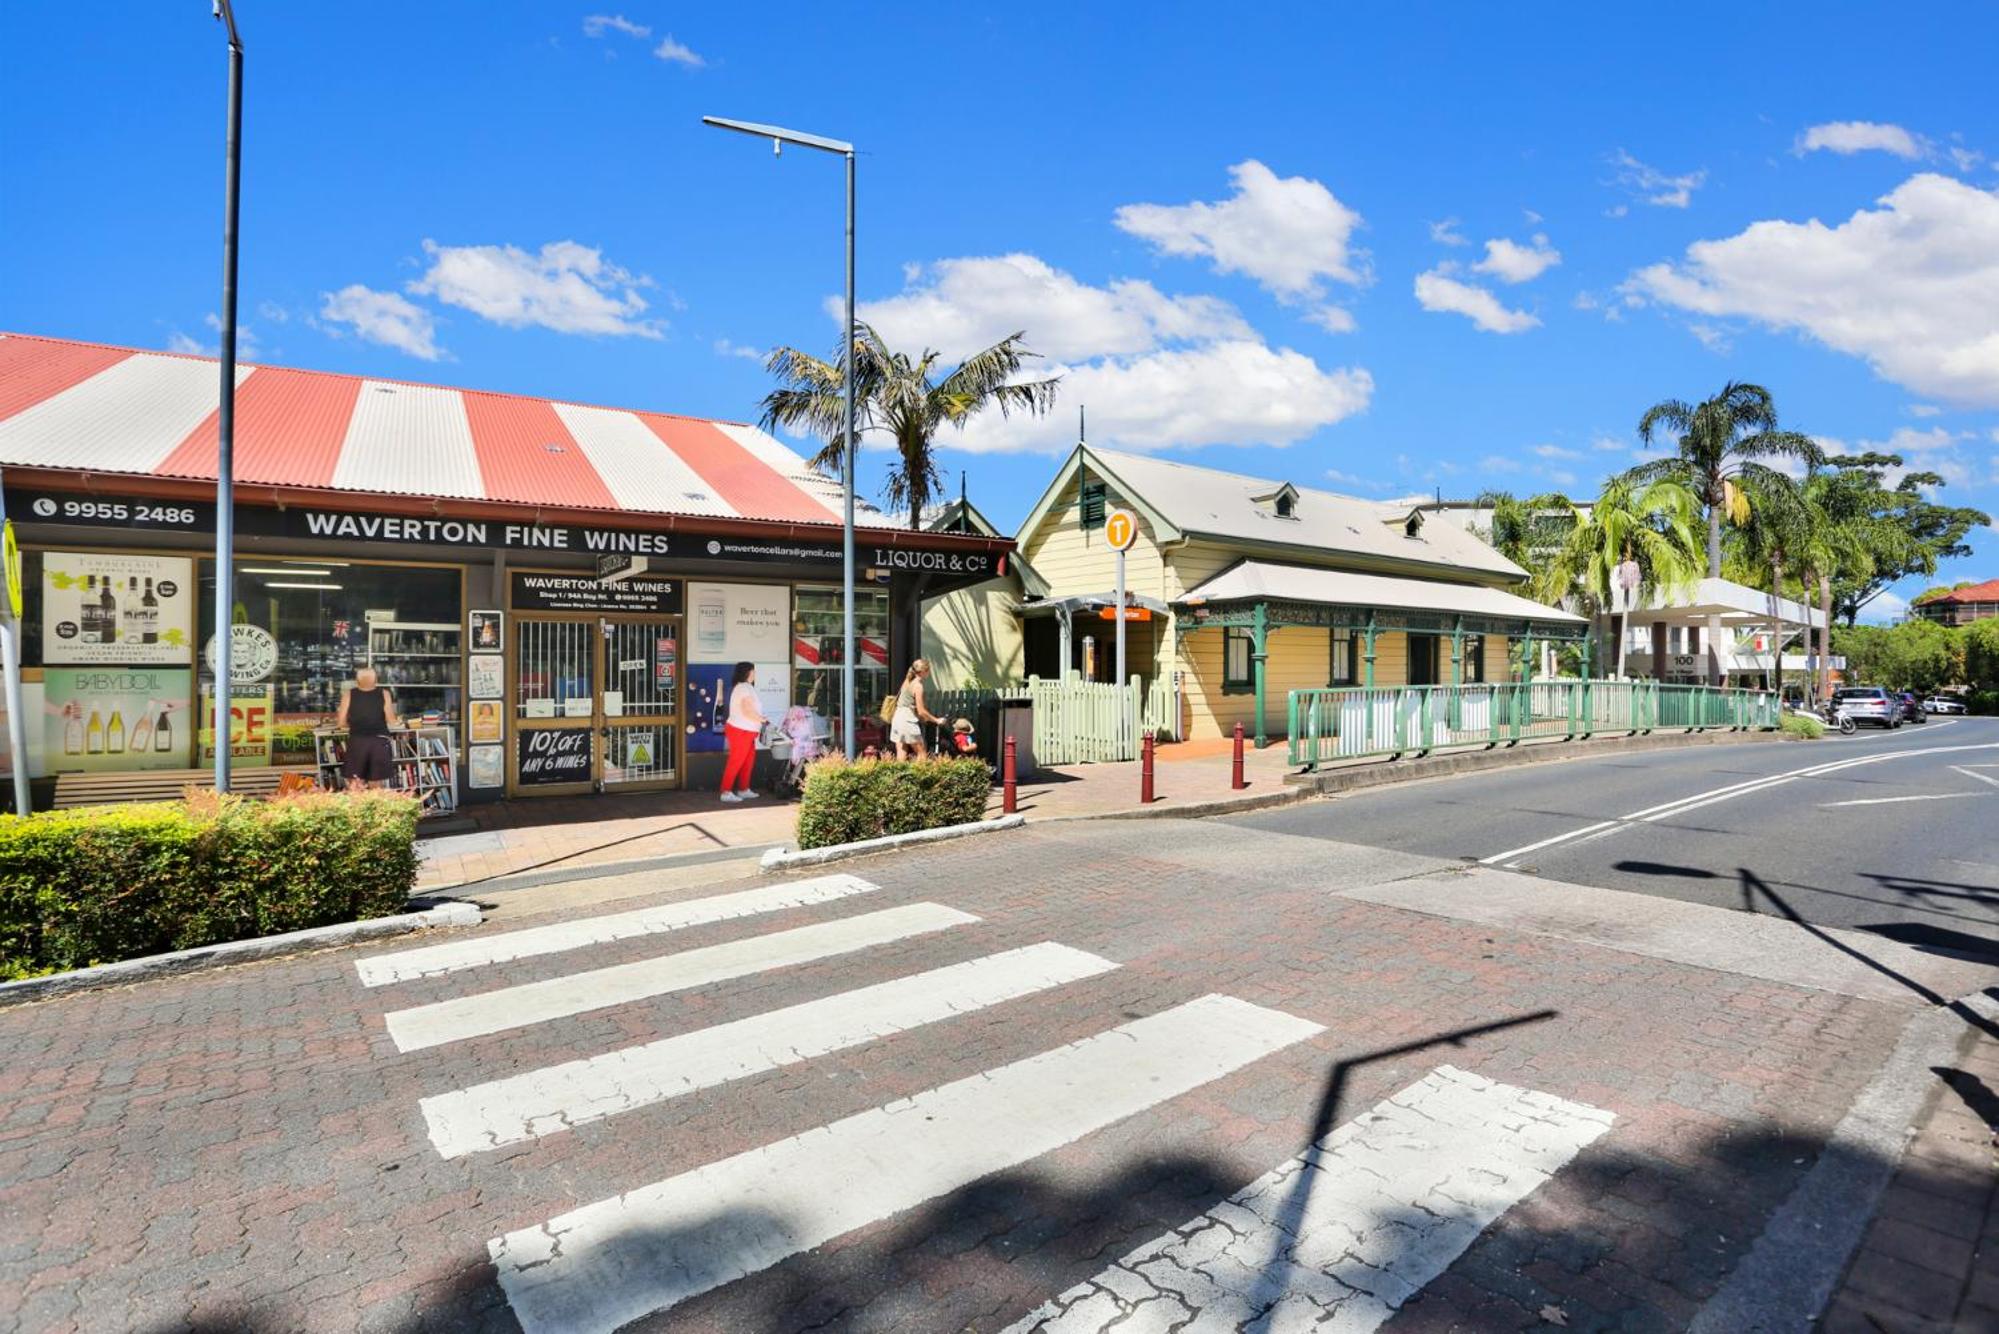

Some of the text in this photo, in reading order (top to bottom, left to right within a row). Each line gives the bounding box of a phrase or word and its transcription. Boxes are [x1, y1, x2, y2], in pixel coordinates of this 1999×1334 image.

[63, 501, 195, 524] 9955 2486
[306, 513, 669, 555] WAVERTON FINE WINES
[1113, 521, 1125, 542] T
[875, 549, 947, 569] LIQUOR
[950, 555, 962, 570] &
[524, 576, 672, 593] WAVERTON FINE WINES
[736, 618, 764, 626] makes
[740, 608, 777, 617] Beer that
[1674, 656, 1695, 666] 100
[75, 673, 162, 690] BABYDOLL
[528, 730, 585, 756] 10% OFF
[521, 753, 588, 774] ANY 6 WINES
